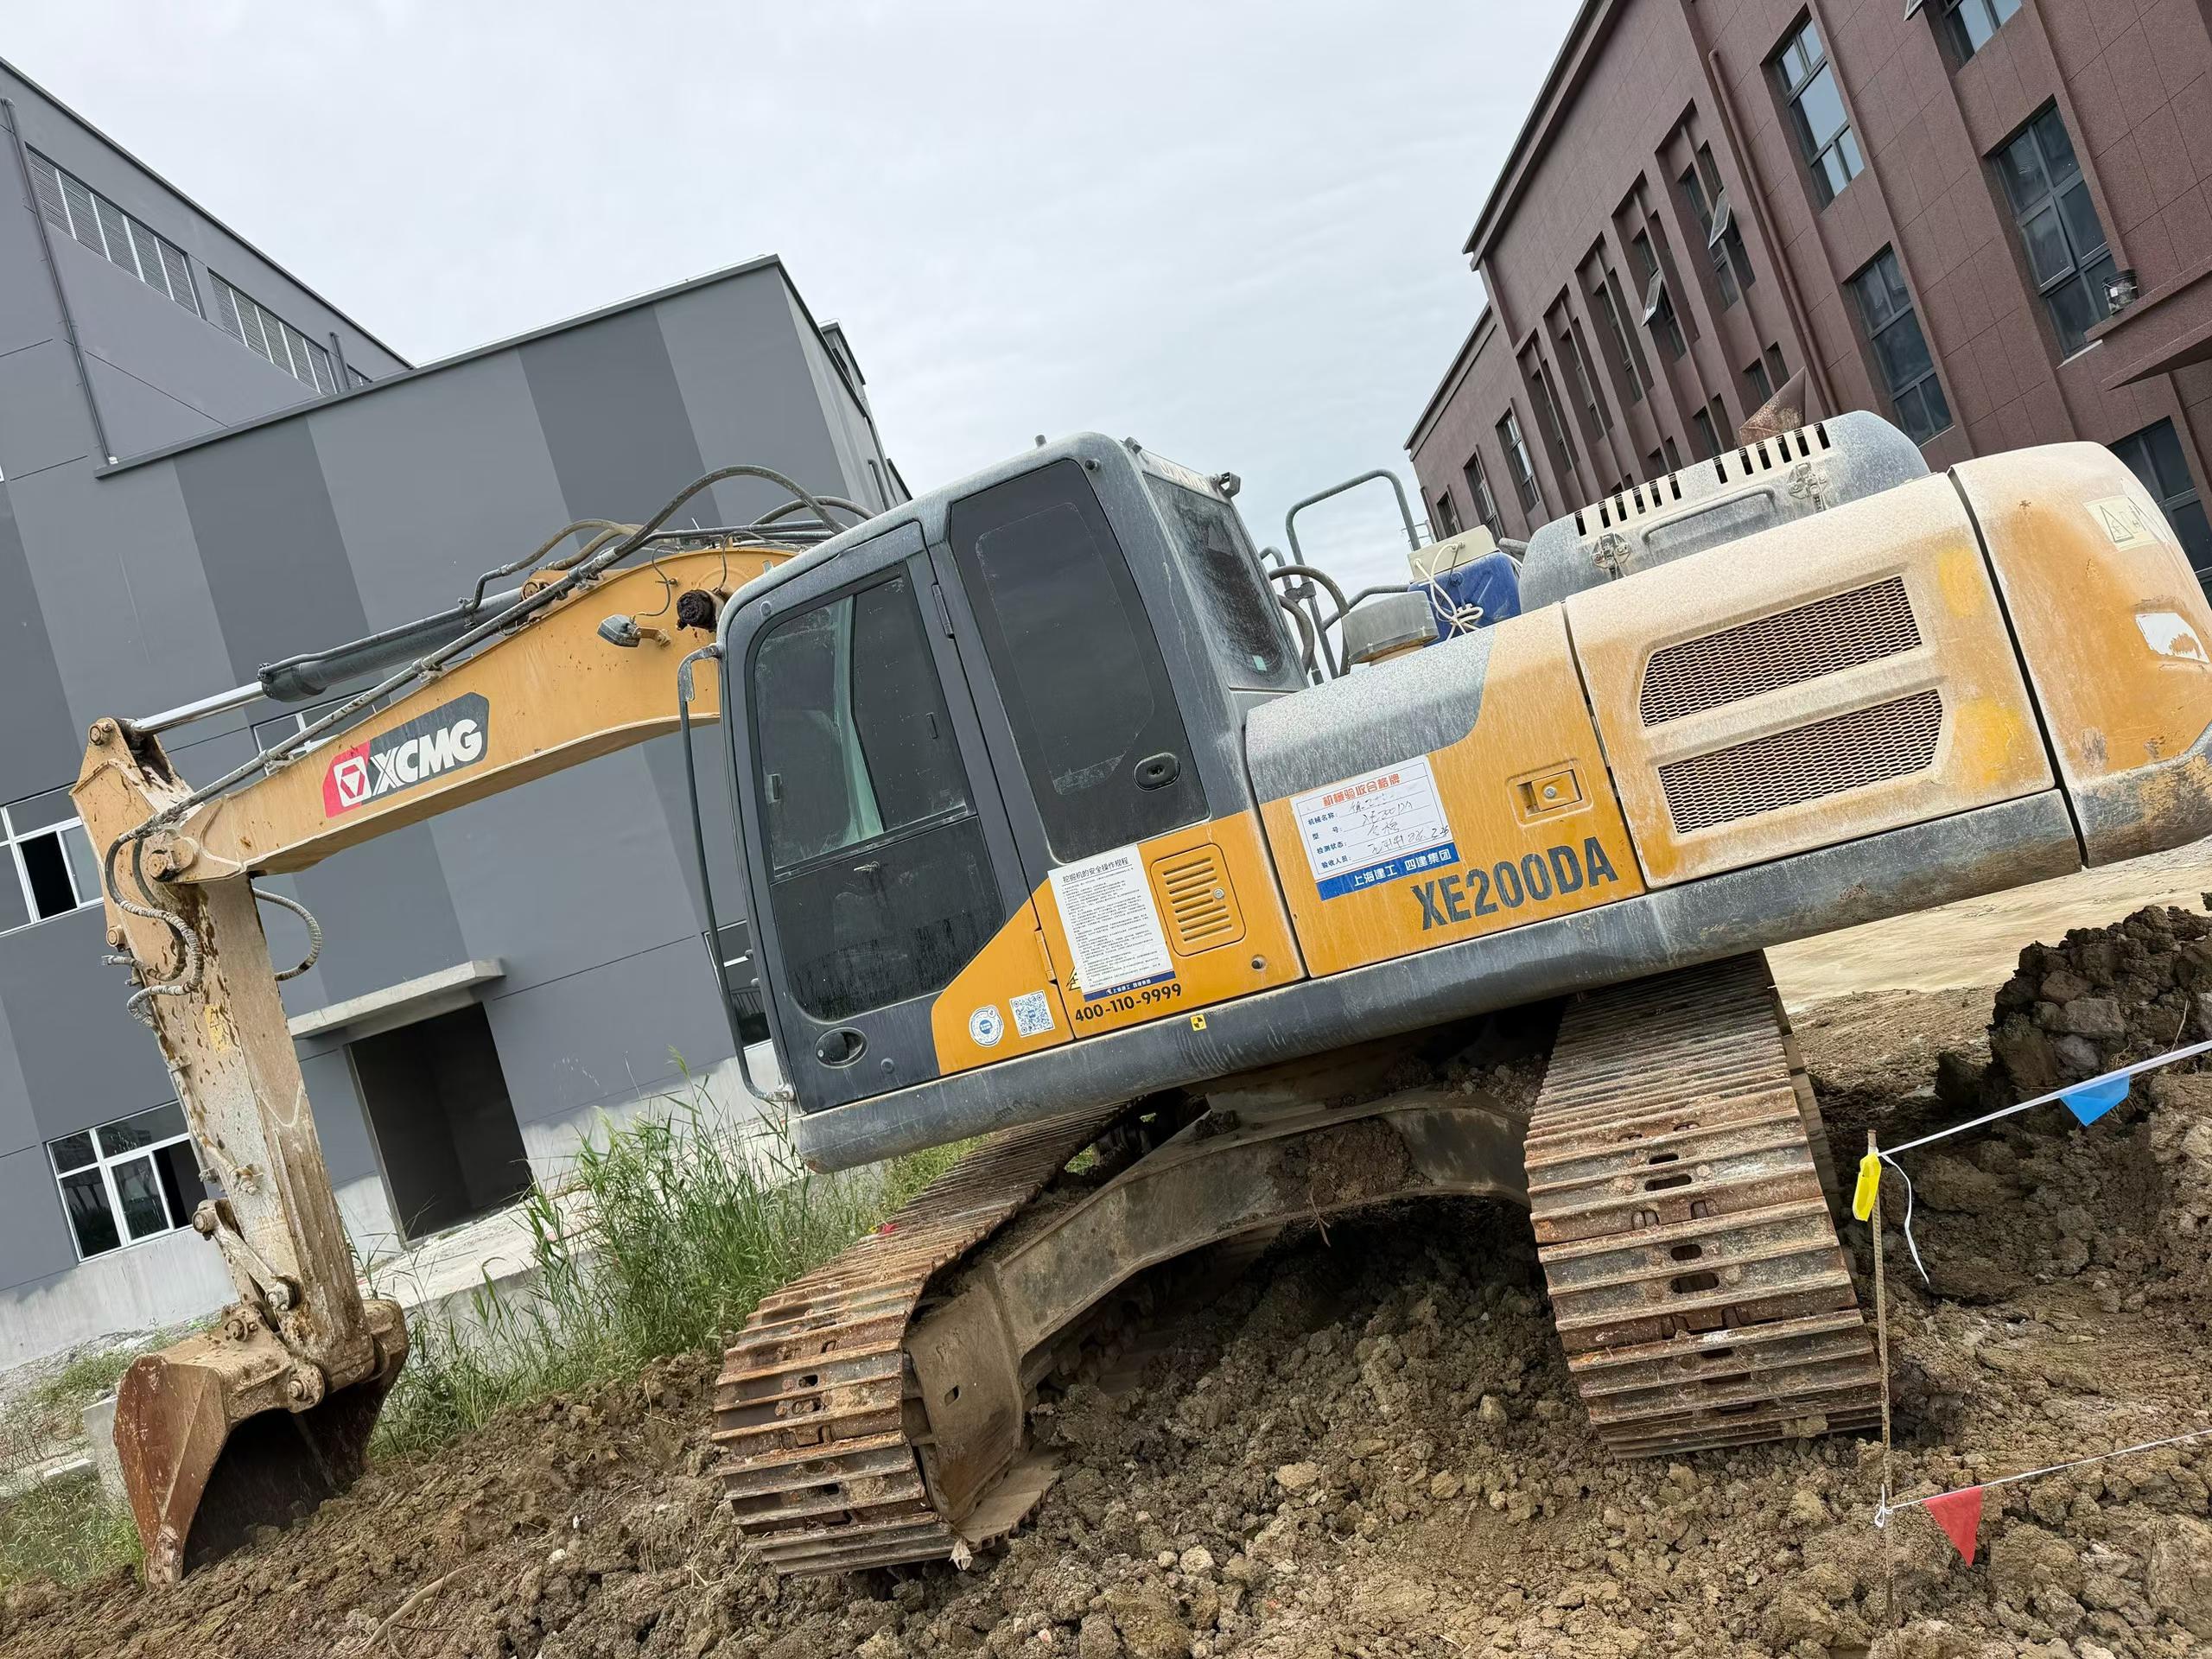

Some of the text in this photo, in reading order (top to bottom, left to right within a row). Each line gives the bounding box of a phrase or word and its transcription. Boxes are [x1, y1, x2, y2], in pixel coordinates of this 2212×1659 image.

[370, 719, 482, 797] XCMG
[1323, 773, 1401, 807] 机械验收合格牌
[1063, 856, 1129, 883] 挖掘机的安全操作规程
[1354, 849, 1452, 887] 上海建工 四建集团
[1410, 836, 1619, 931] XE200DA
[1075, 982, 1182, 1022] 400-110-9999
